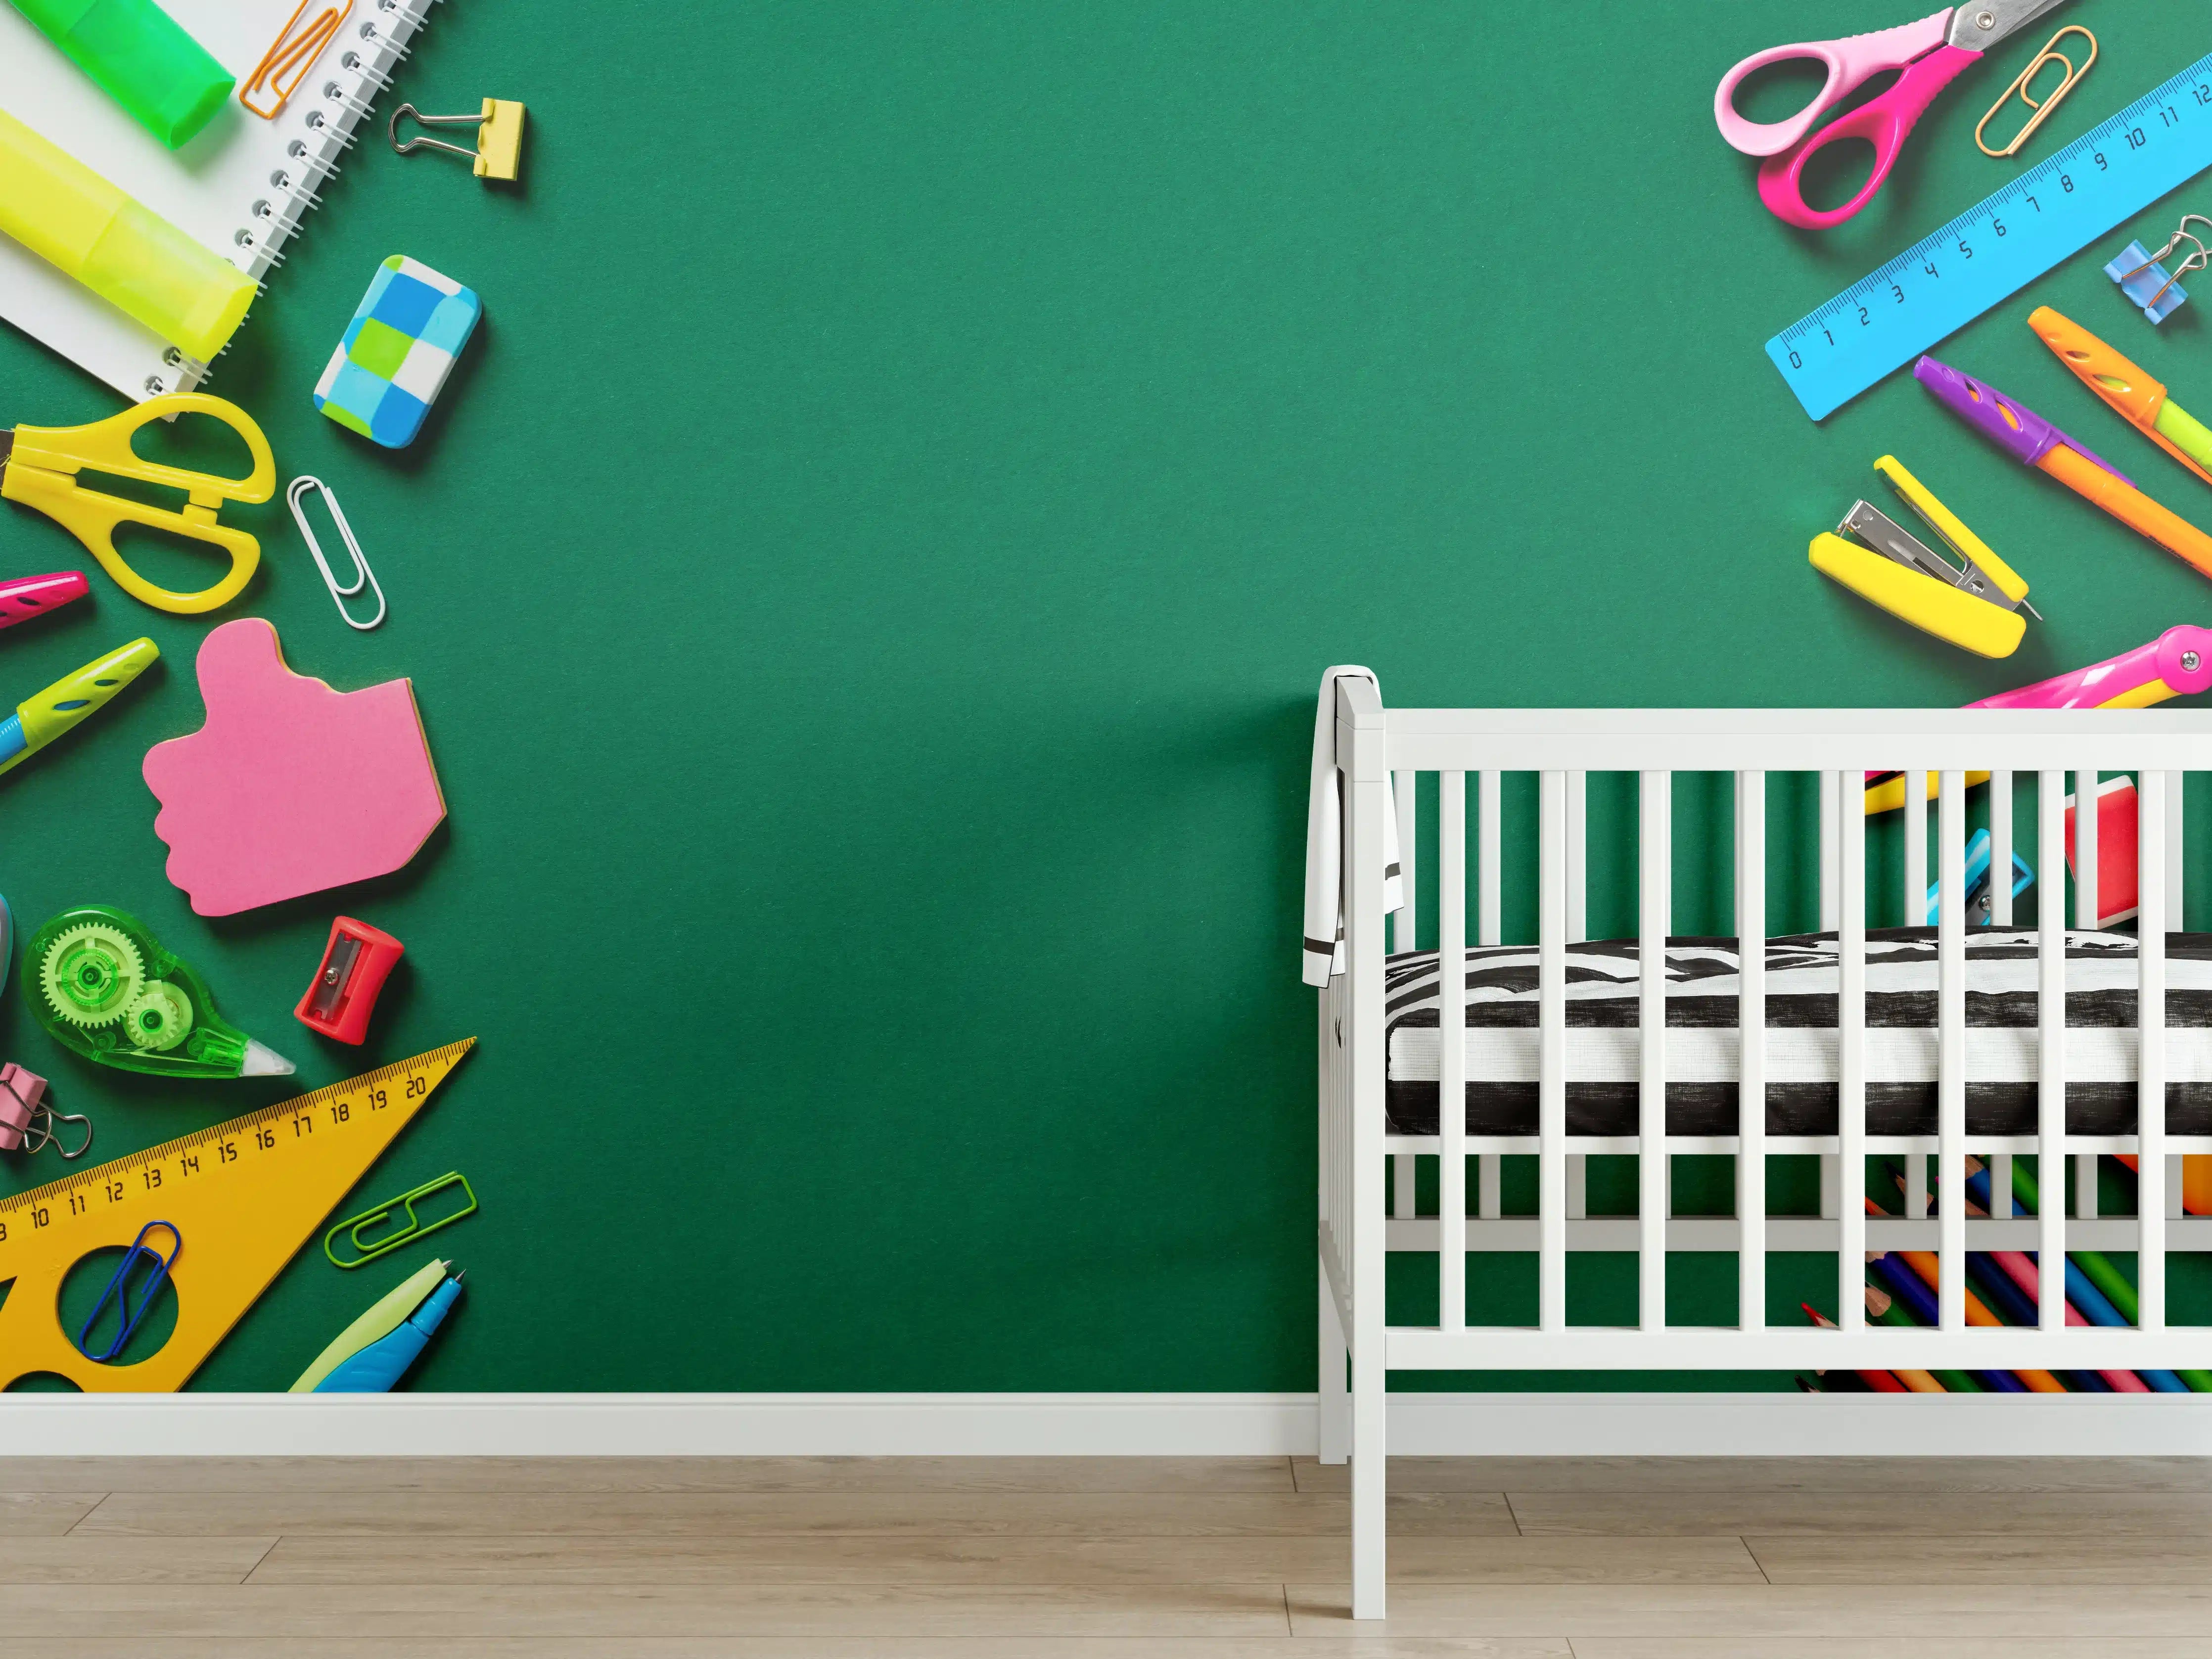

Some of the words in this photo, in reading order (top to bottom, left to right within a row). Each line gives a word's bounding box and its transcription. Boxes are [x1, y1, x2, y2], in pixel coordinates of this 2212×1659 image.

[1790, 351, 1802, 369] 0
[1824, 330, 1834, 346] 1
[1858, 307, 1870, 326] 2
[1892, 285, 1904, 304] 3
[1925, 263, 1938, 278] 4
[1959, 240, 1973, 259] 5
[1993, 219, 2006, 237] 6
[2026, 196, 2040, 212] 7
[2061, 175, 2074, 193] 8
[2094, 153, 2108, 171] 9
[2124, 128, 2146, 150] 10
[2160, 106, 2178, 127] 11
[2192, 84, 2212, 106] 12
[31, 1208, 49, 1229] 10
[69, 1195, 85, 1216] 11
[105, 1182, 124, 1203] 12
[143, 1169, 162, 1190] 13
[180, 1155, 199, 1177] 14
[218, 1142, 237, 1164] 15
[255, 1129, 275, 1151] 16
[292, 1116, 312, 1137] 17
[330, 1103, 350, 1124] 18
[368, 1090, 387, 1111] 19
[406, 1076, 426, 1099] 20
